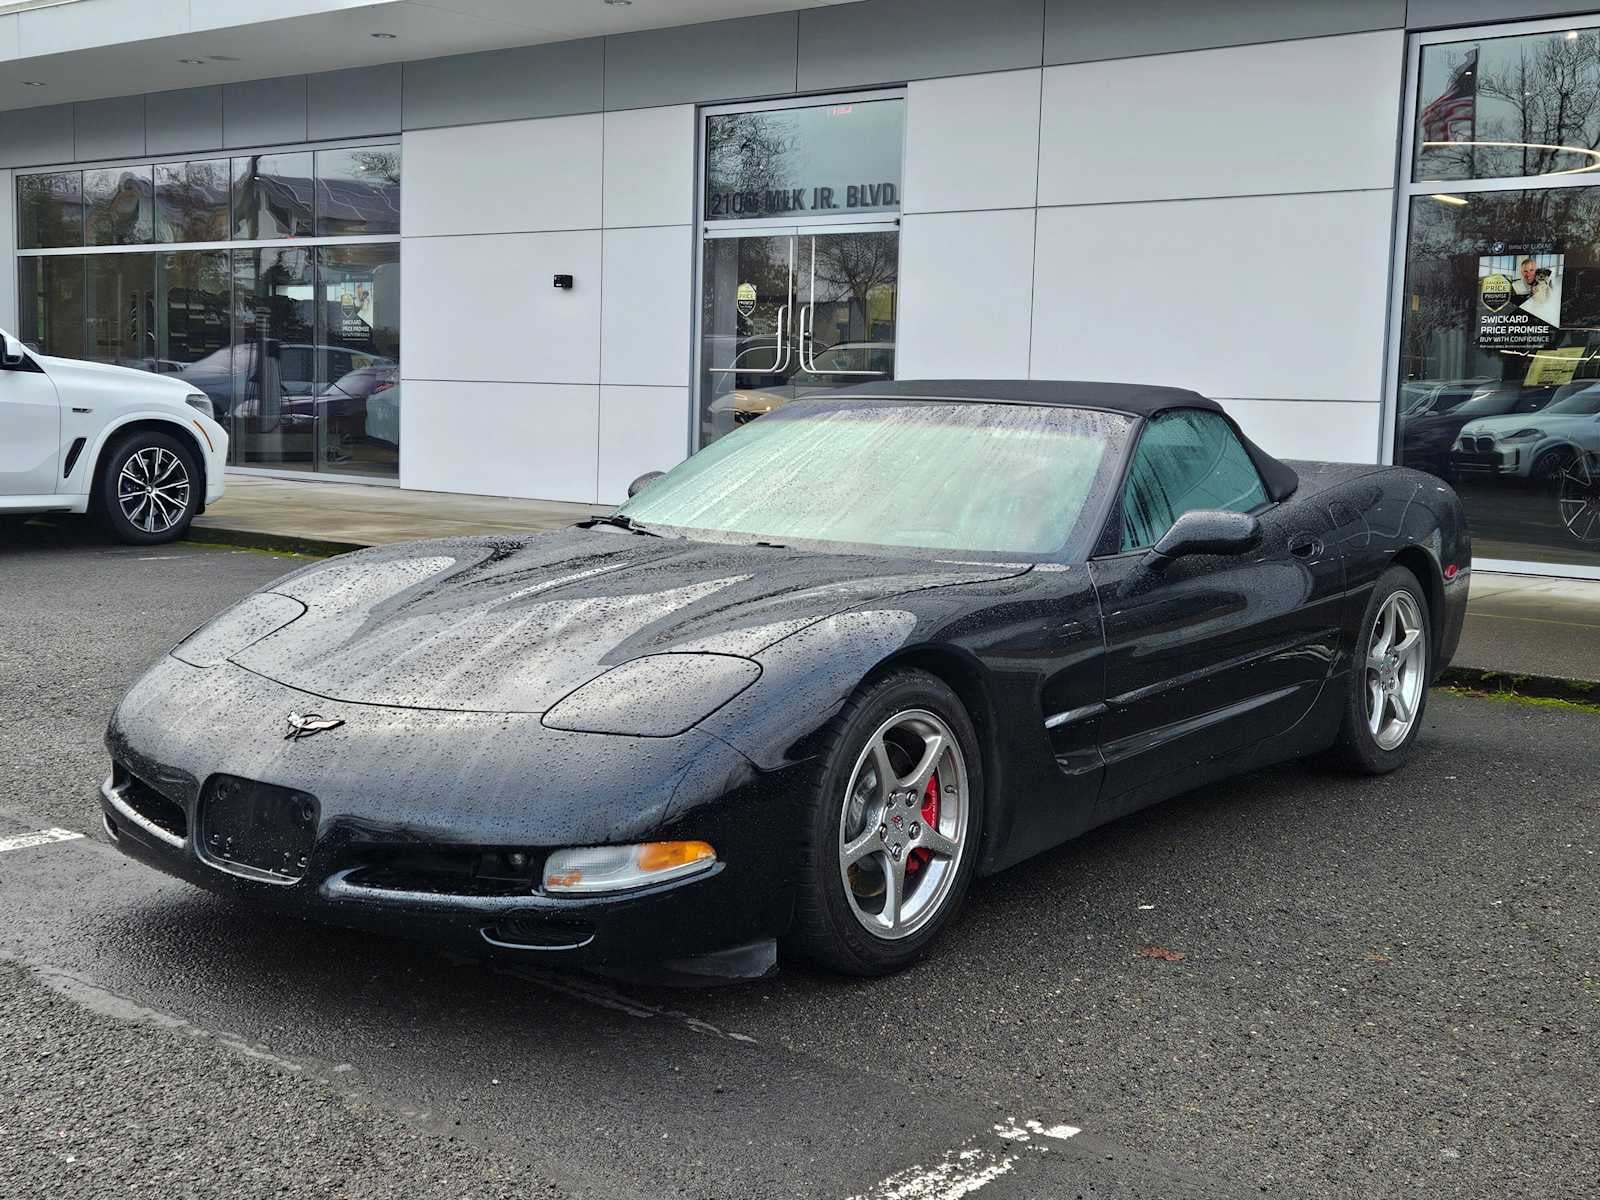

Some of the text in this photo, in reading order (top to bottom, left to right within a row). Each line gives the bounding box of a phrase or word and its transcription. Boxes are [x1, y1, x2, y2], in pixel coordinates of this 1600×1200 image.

[766, 187, 807, 212] MLK
[811, 186, 840, 209] JR.
[846, 183, 900, 208] BLVD.
[1481, 315, 1529, 324] SWICKARD
[1480, 325, 1550, 334] PRICE PROMISE
[1510, 335, 1550, 343] CONFIDENCE
